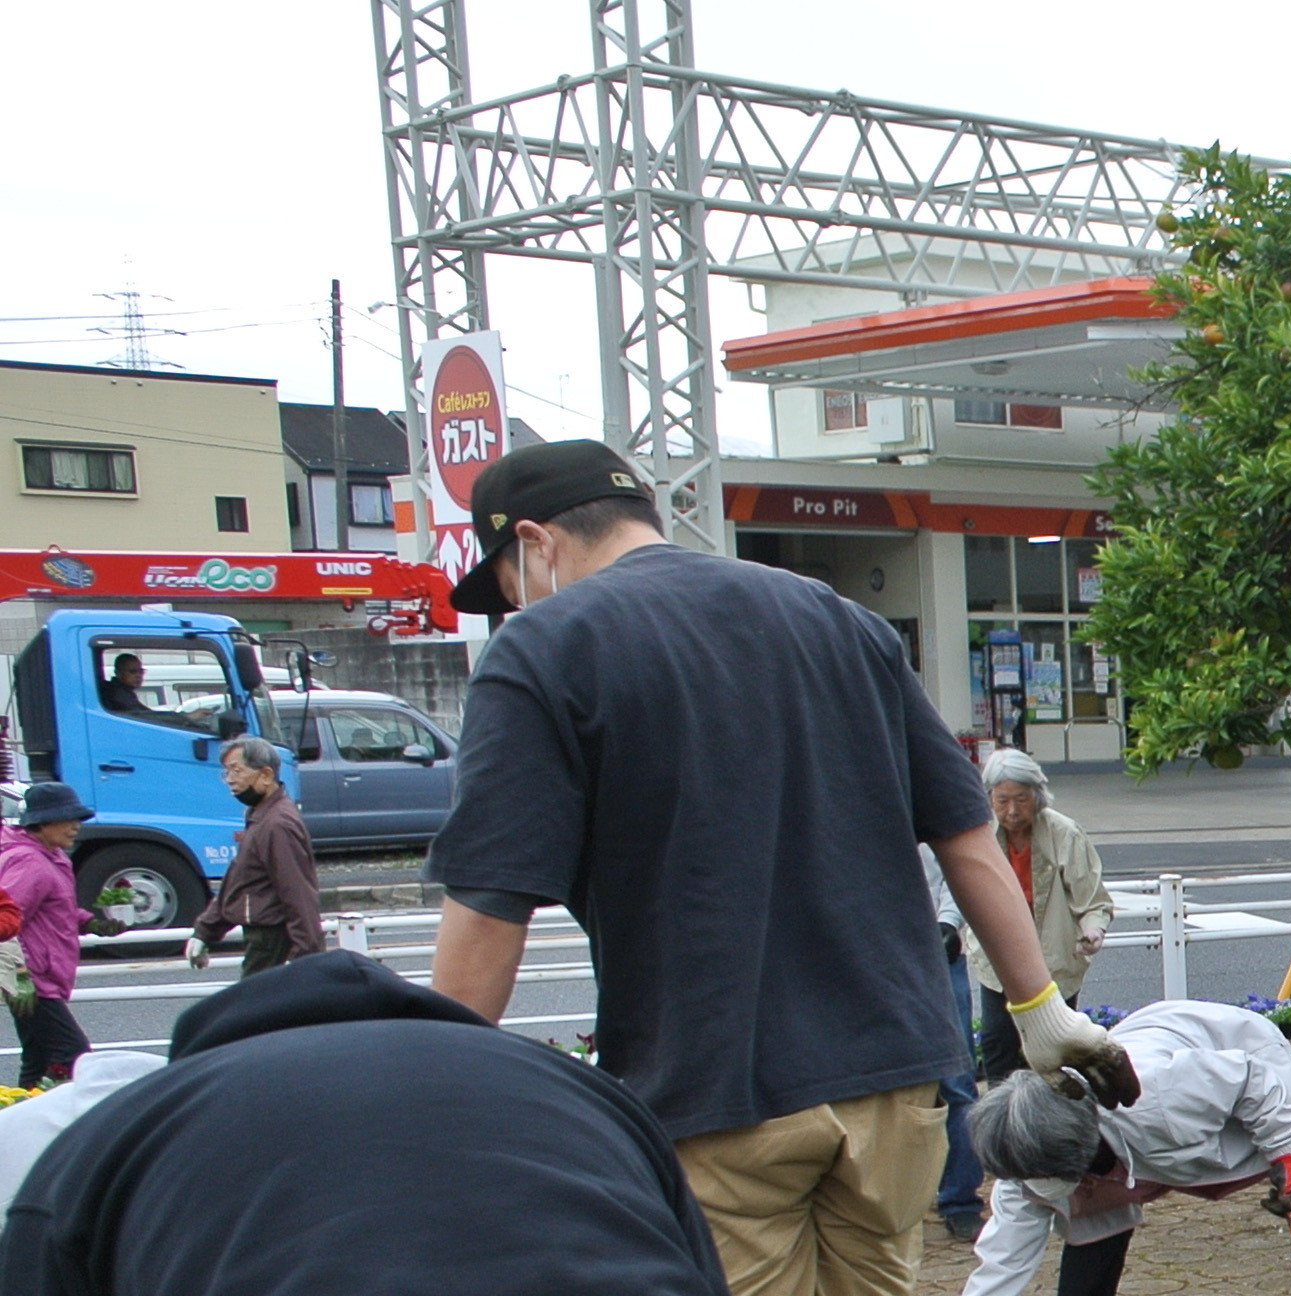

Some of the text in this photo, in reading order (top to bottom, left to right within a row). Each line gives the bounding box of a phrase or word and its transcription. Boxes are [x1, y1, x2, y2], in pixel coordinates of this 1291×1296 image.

[437, 391, 491, 414] Caféレストラン
[441, 418, 497, 465] ガスト
[792, 496, 859, 518] Pro Pit
[316, 561, 373, 577] UNIC
